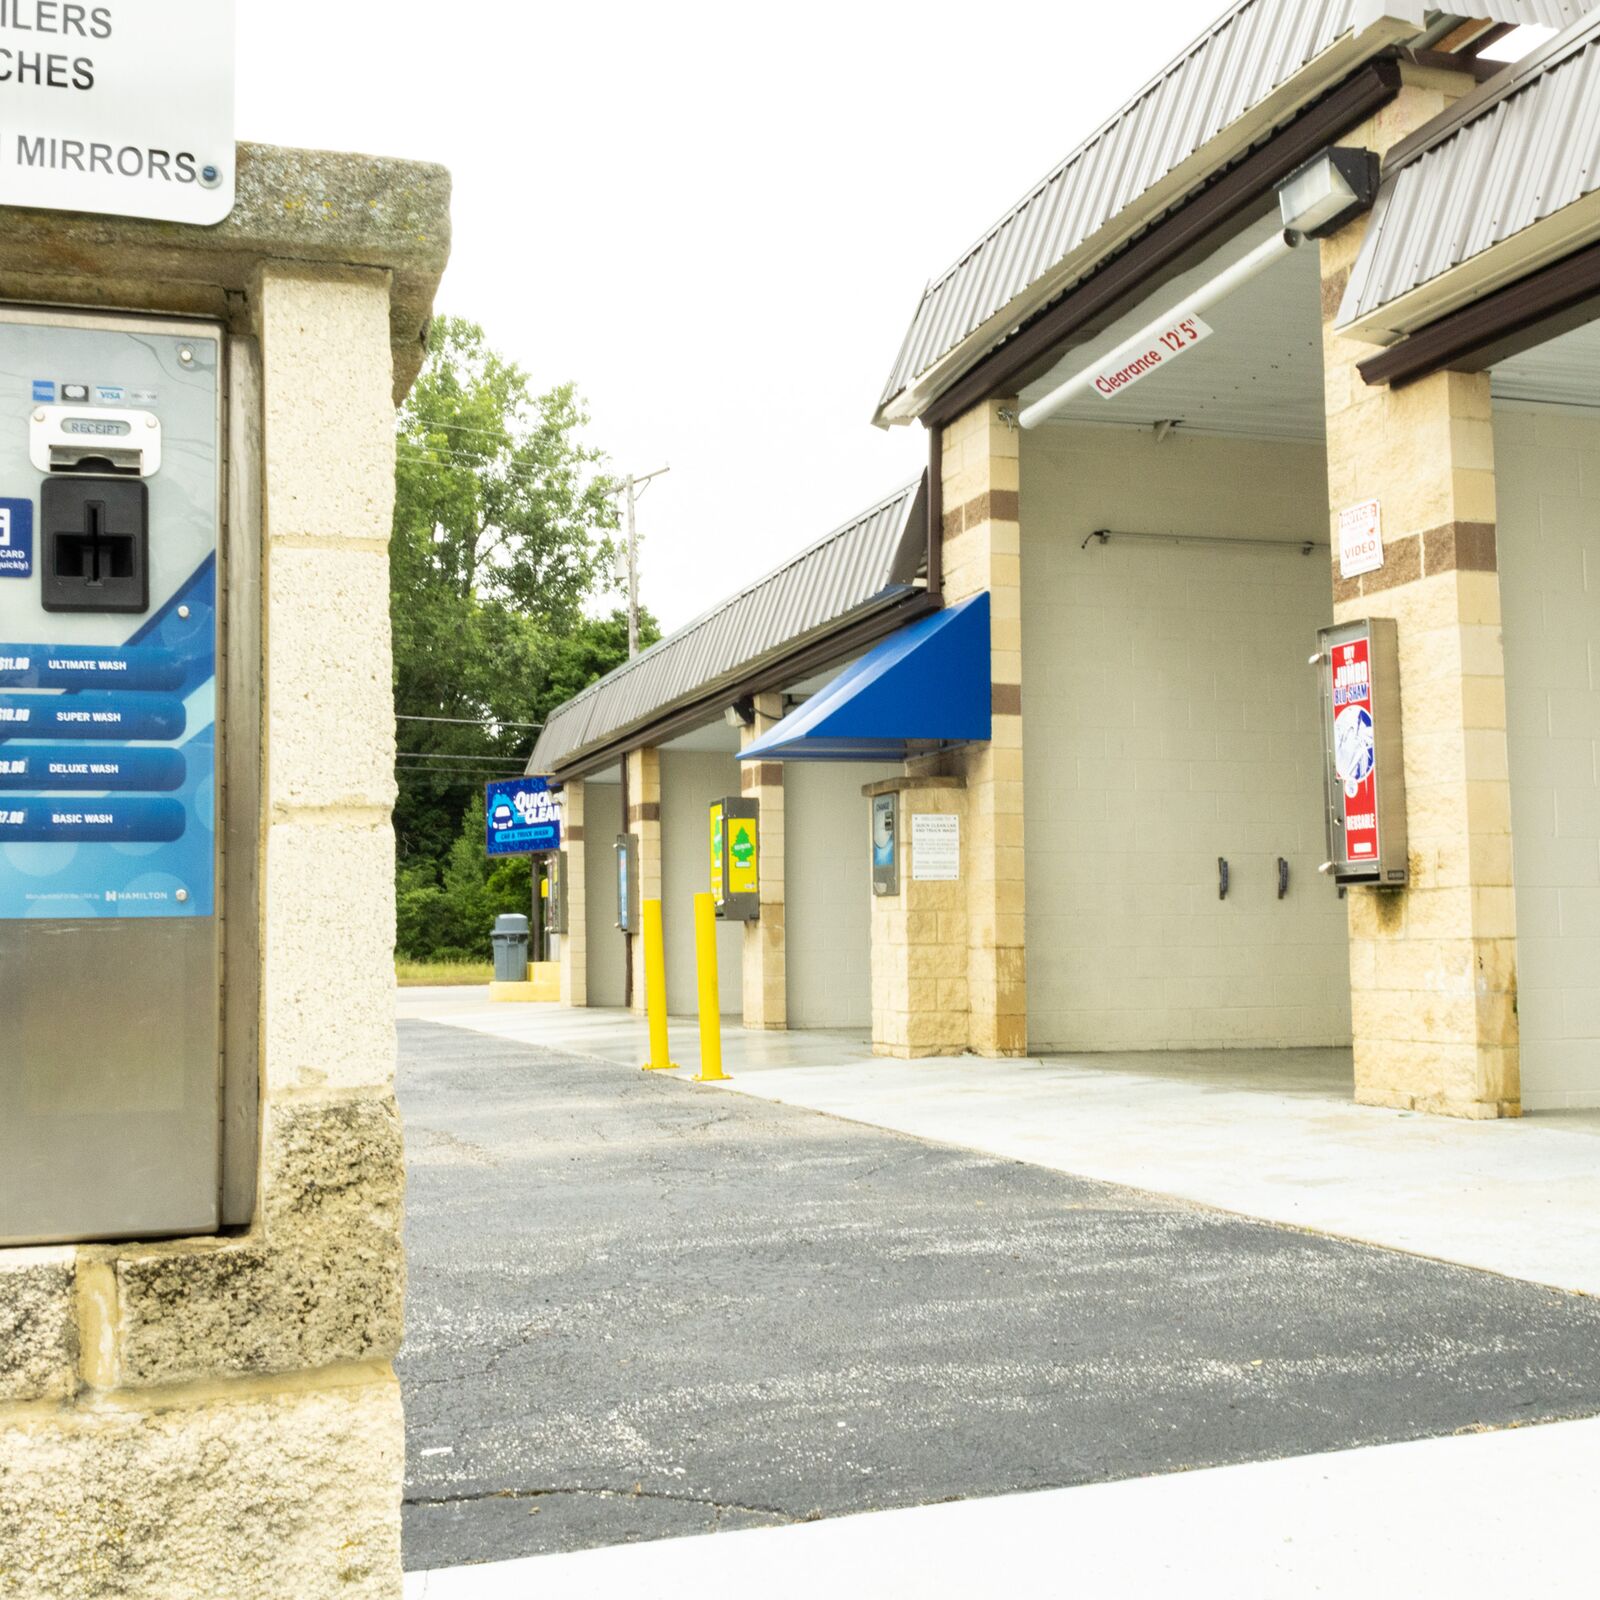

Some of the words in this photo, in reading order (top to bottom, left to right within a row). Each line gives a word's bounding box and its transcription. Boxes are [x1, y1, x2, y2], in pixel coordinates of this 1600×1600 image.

[17, 135, 197, 183] MIRRORS
[1095, 350, 1162, 394] Clearance
[101, 391, 121, 400] VISA
[71, 422, 121, 435] RECEIPT
[1344, 540, 1376, 559] VIDEO
[48, 660, 97, 670] ULTIMATE
[98, 660, 127, 671] WASH
[56, 711, 91, 722] SUPER
[92, 712, 121, 722] WASH
[48, 763, 89, 773] DELUXE
[90, 763, 119, 774] WASH
[514, 790, 553, 813] QUICK
[52, 814, 83, 824] BASIC
[84, 813, 113, 824] WASH
[117, 891, 168, 900] HAMILTON
